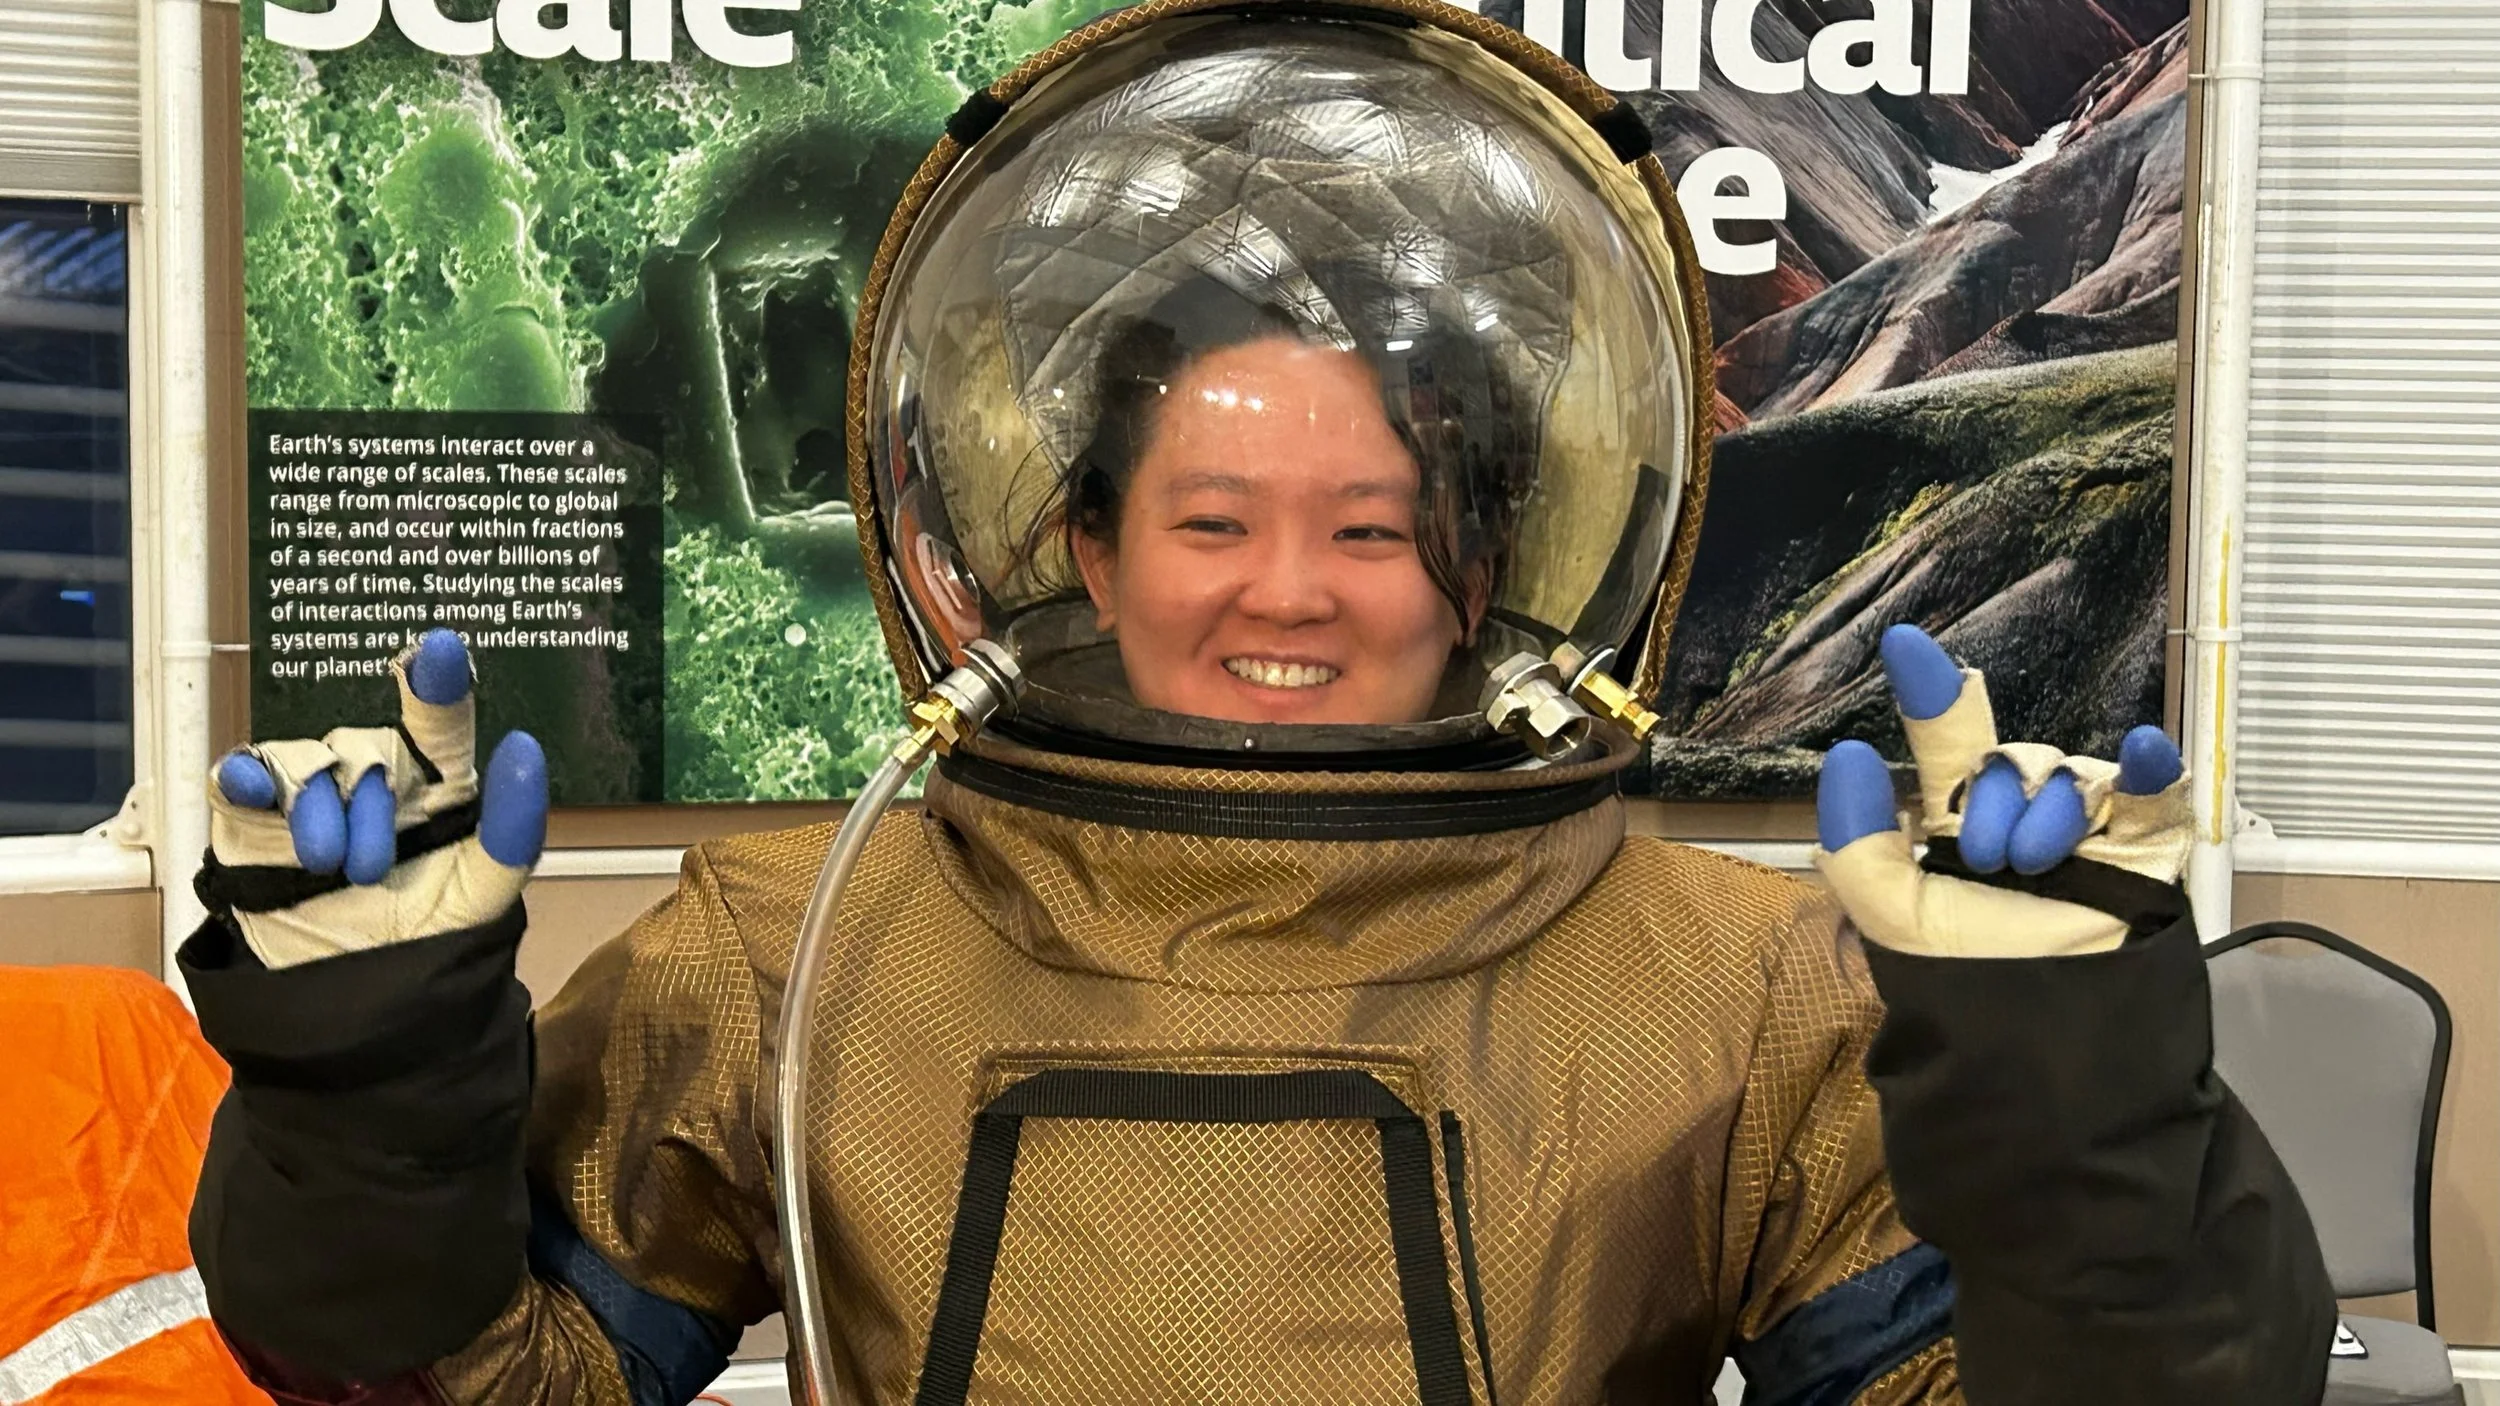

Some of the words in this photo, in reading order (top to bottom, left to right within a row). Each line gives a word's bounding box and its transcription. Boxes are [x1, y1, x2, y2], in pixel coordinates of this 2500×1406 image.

[270, 434, 342, 454] Earth's
[349, 438, 435, 459] systems
[442, 435, 524, 455] interact
[530, 440, 576, 456] over
[582, 440, 594, 456] a
[270, 462, 320, 482] wide
[328, 466, 388, 487] range
[395, 462, 417, 482] of
[422, 463, 490, 483] scales.
[497, 463, 558, 483] These
[565, 464, 627, 484] scales
[271, 494, 331, 515] range
[338, 490, 389, 510] from
[397, 490, 522, 515] microscopic
[529, 494, 550, 511] to
[555, 491, 617, 515] global
[271, 518, 289, 538] in
[297, 518, 341, 541] size,
[349, 517, 389, 538] and
[396, 522, 454, 538] occur
[460, 518, 525, 538] within
[532, 518, 623, 538] fractions
[271, 545, 293, 566] of
[298, 550, 310, 566] a
[317, 545, 392, 566] second
[399, 545, 439, 565] and
[445, 550, 492, 565] over
[499, 545, 573, 565] billions
[579, 545, 600, 565] of
[270, 578, 329, 598] years
[335, 573, 357, 593] of
[363, 574, 416, 593] time.
[423, 573, 515, 597] Studying
[521, 573, 555, 592] the
[561, 573, 623, 592] scales
[271, 601, 293, 621] of
[300, 601, 427, 621] interactions
[433, 604, 506, 624] among
[513, 600, 582, 620] Earth's
[272, 632, 358, 654] systems
[365, 632, 399, 648] are
[477, 626, 629, 652] understanding
[272, 661, 308, 677] our
[316, 656, 394, 682] planet'
